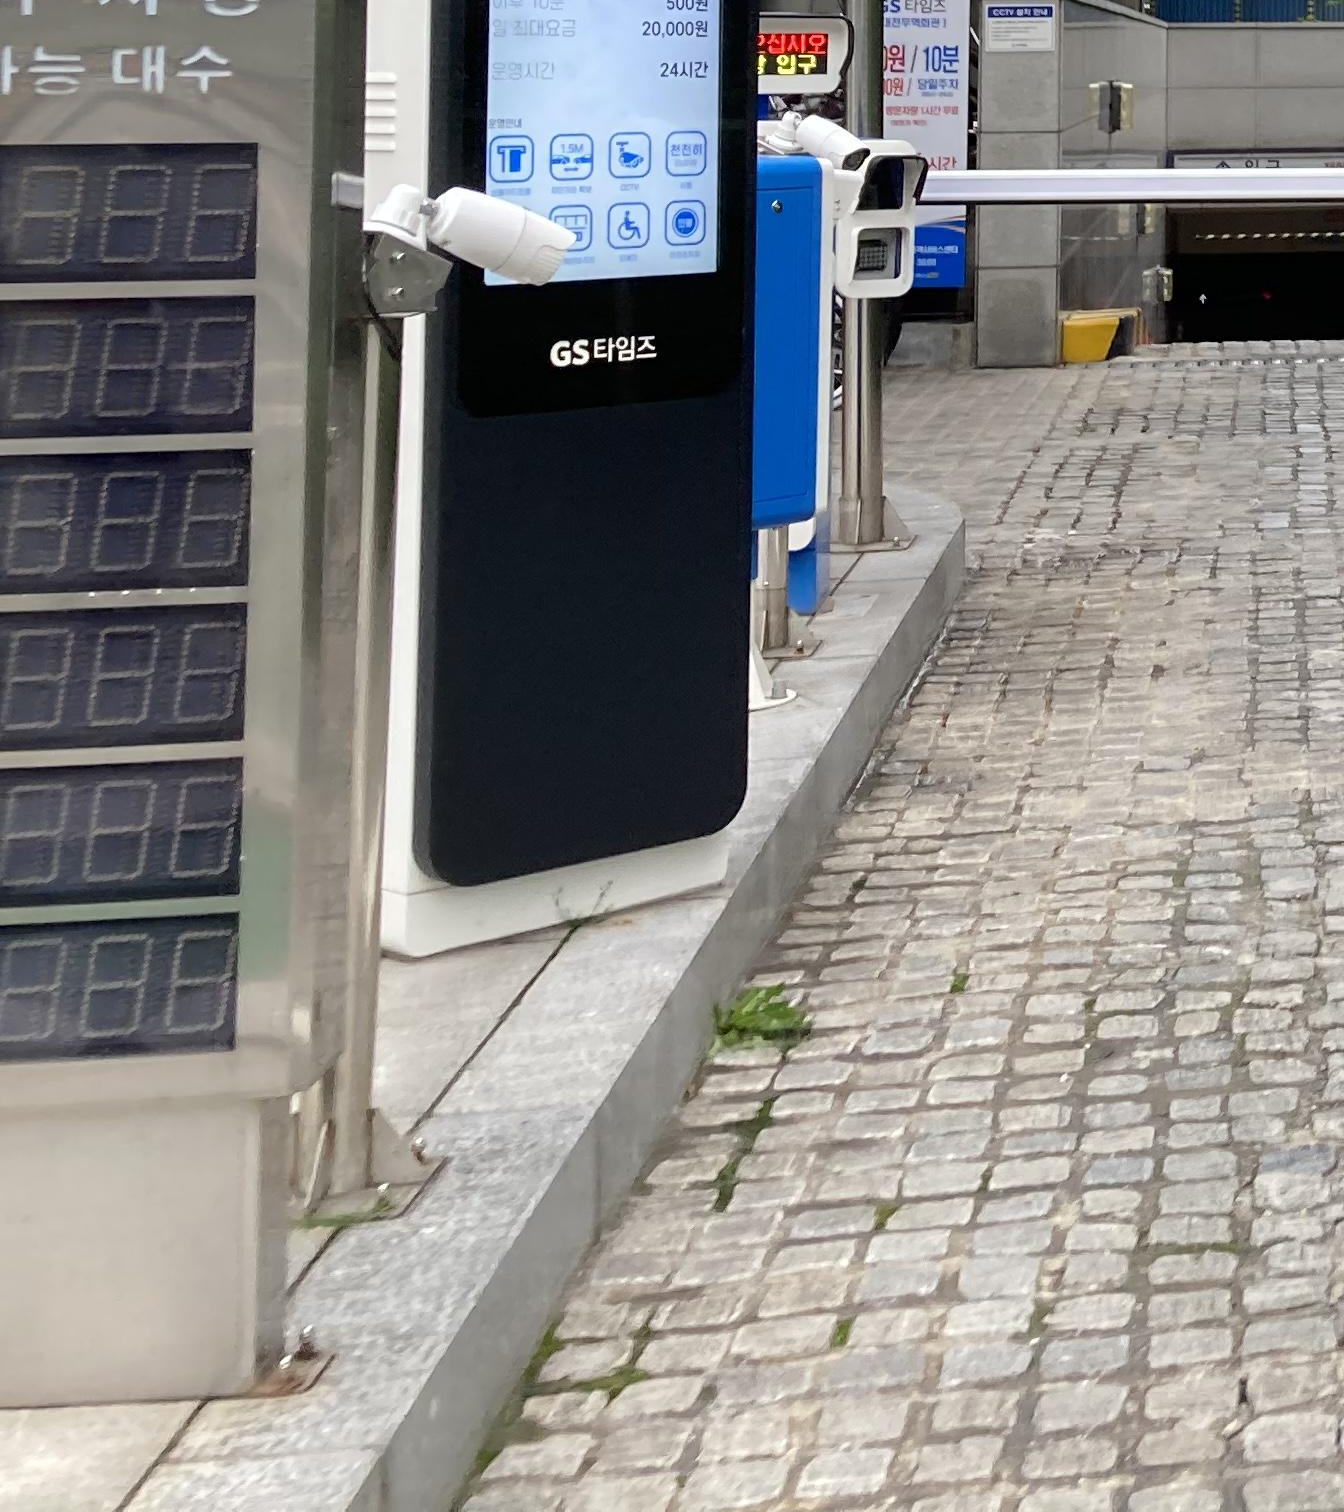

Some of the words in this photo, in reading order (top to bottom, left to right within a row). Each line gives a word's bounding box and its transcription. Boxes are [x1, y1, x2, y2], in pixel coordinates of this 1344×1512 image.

[904, 0, 946, 13] 타임즈
[992, 8, 1014, 17] CCTV
[513, 19, 577, 37] 최대요금
[642, 21, 709, 38] 20,000원
[776, 54, 817, 75] 입구
[923, 45, 960, 74] 10분
[112, 46, 232, 94] 대수
[491, 61, 556, 81] 운영시간
[660, 61, 709, 79] 24시간
[561, 143, 584, 154] 1.5M
